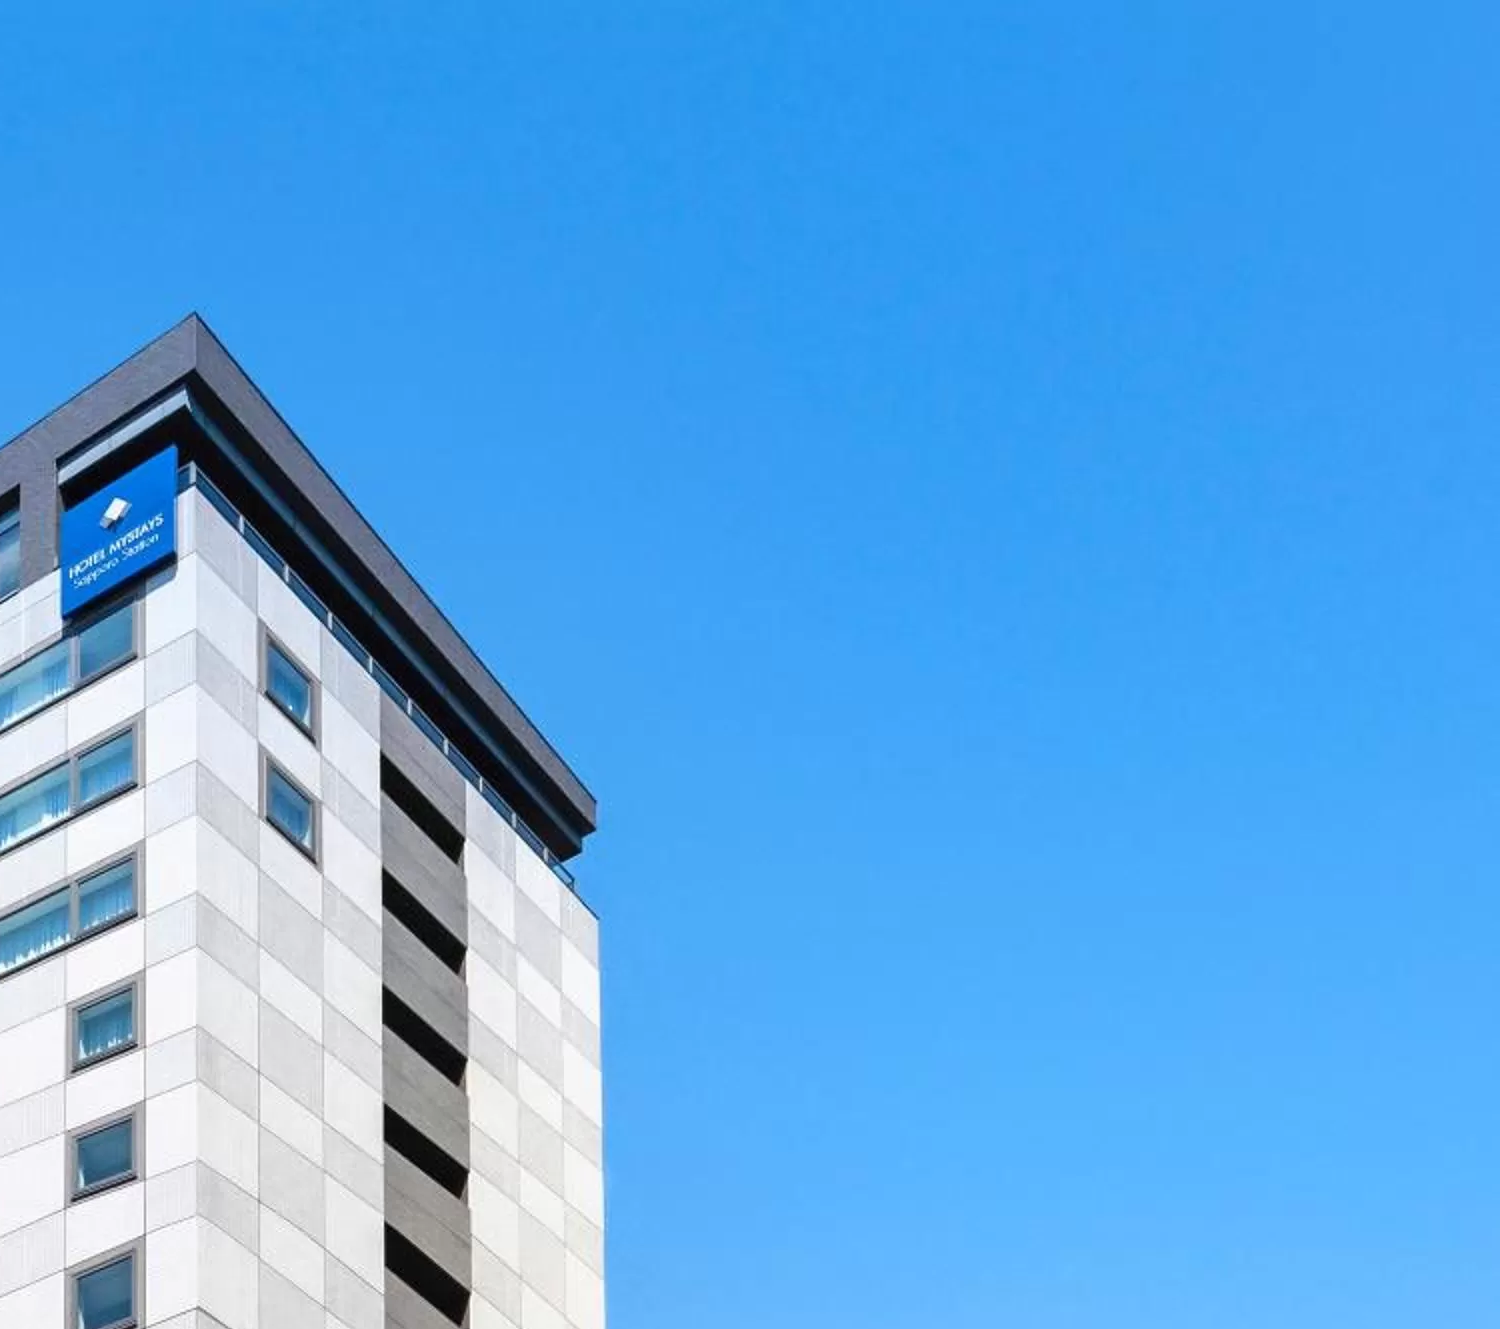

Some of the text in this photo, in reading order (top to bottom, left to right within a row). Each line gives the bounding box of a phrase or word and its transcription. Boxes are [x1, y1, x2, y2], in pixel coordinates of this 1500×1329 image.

[69, 512, 164, 579] HOTEL MYSTAYS
[73, 533, 160, 589] Sapporo Station
